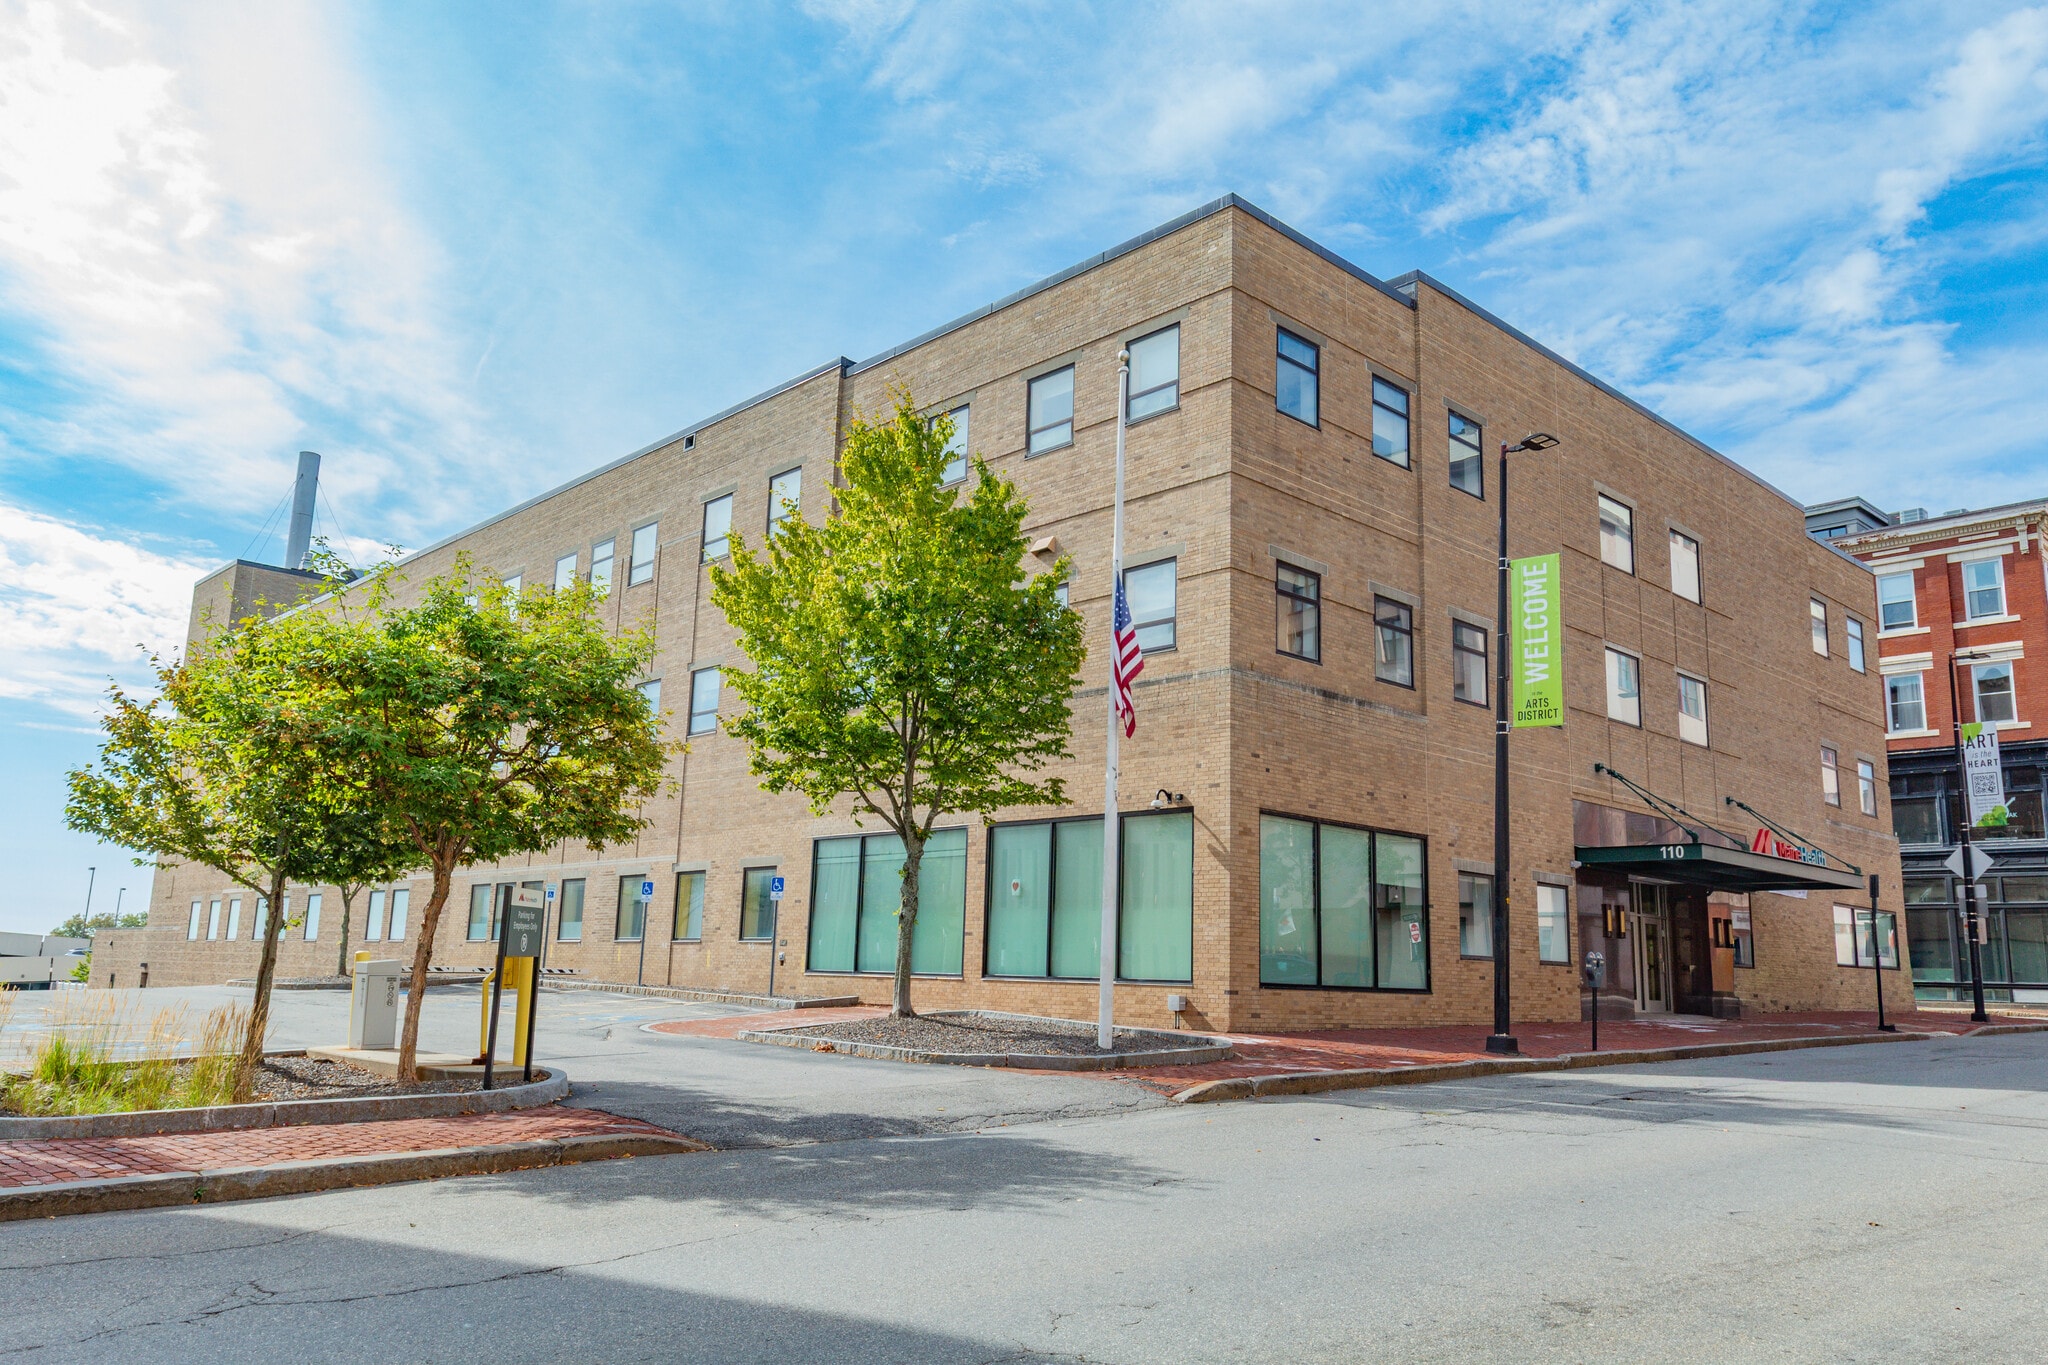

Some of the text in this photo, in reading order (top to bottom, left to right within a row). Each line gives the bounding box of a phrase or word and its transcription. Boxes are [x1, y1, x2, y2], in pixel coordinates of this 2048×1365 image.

[1523, 562, 1548, 684] WELCOME
[1525, 697, 1549, 709] ARTS
[1517, 707, 1558, 721] DISTRICT
[1966, 733, 1995, 750] ART
[1980, 750, 1992, 758] the
[1967, 758, 1998, 769] HEART
[1660, 845, 1684, 859] 110
[518, 910, 530, 921] Parking
